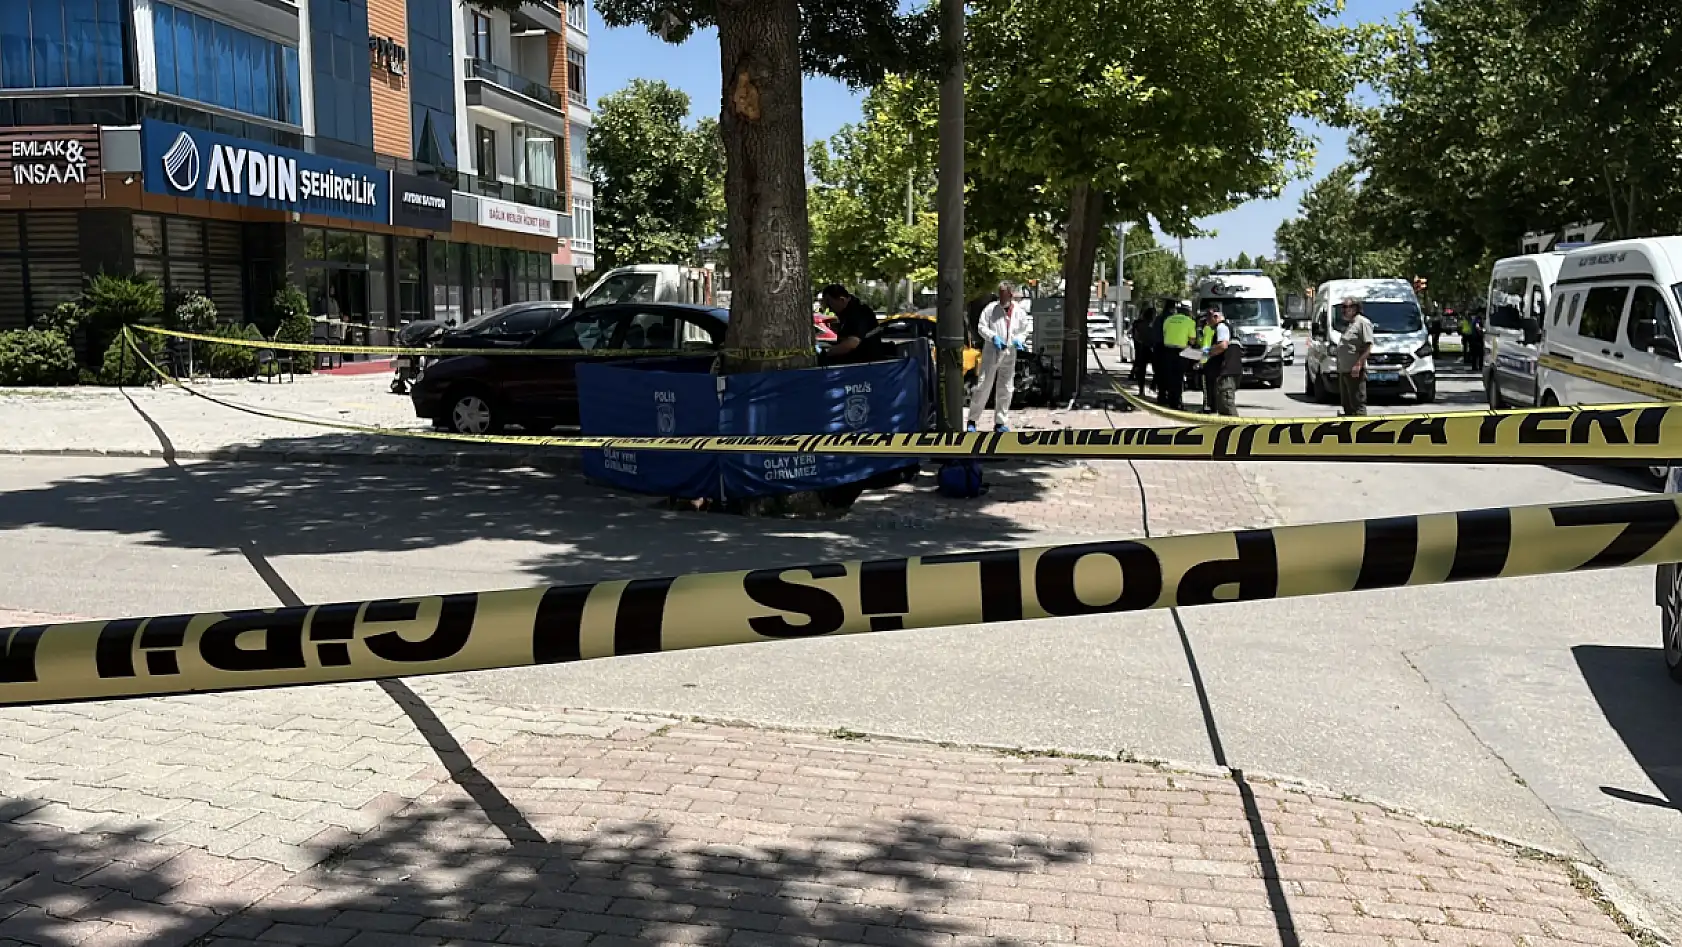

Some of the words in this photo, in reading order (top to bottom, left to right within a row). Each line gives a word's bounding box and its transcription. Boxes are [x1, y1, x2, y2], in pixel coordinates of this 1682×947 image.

[206, 144, 296, 202] AYDIN
[763, 456, 790, 469] OLAY
[743, 529, 1278, 639] POLİS
